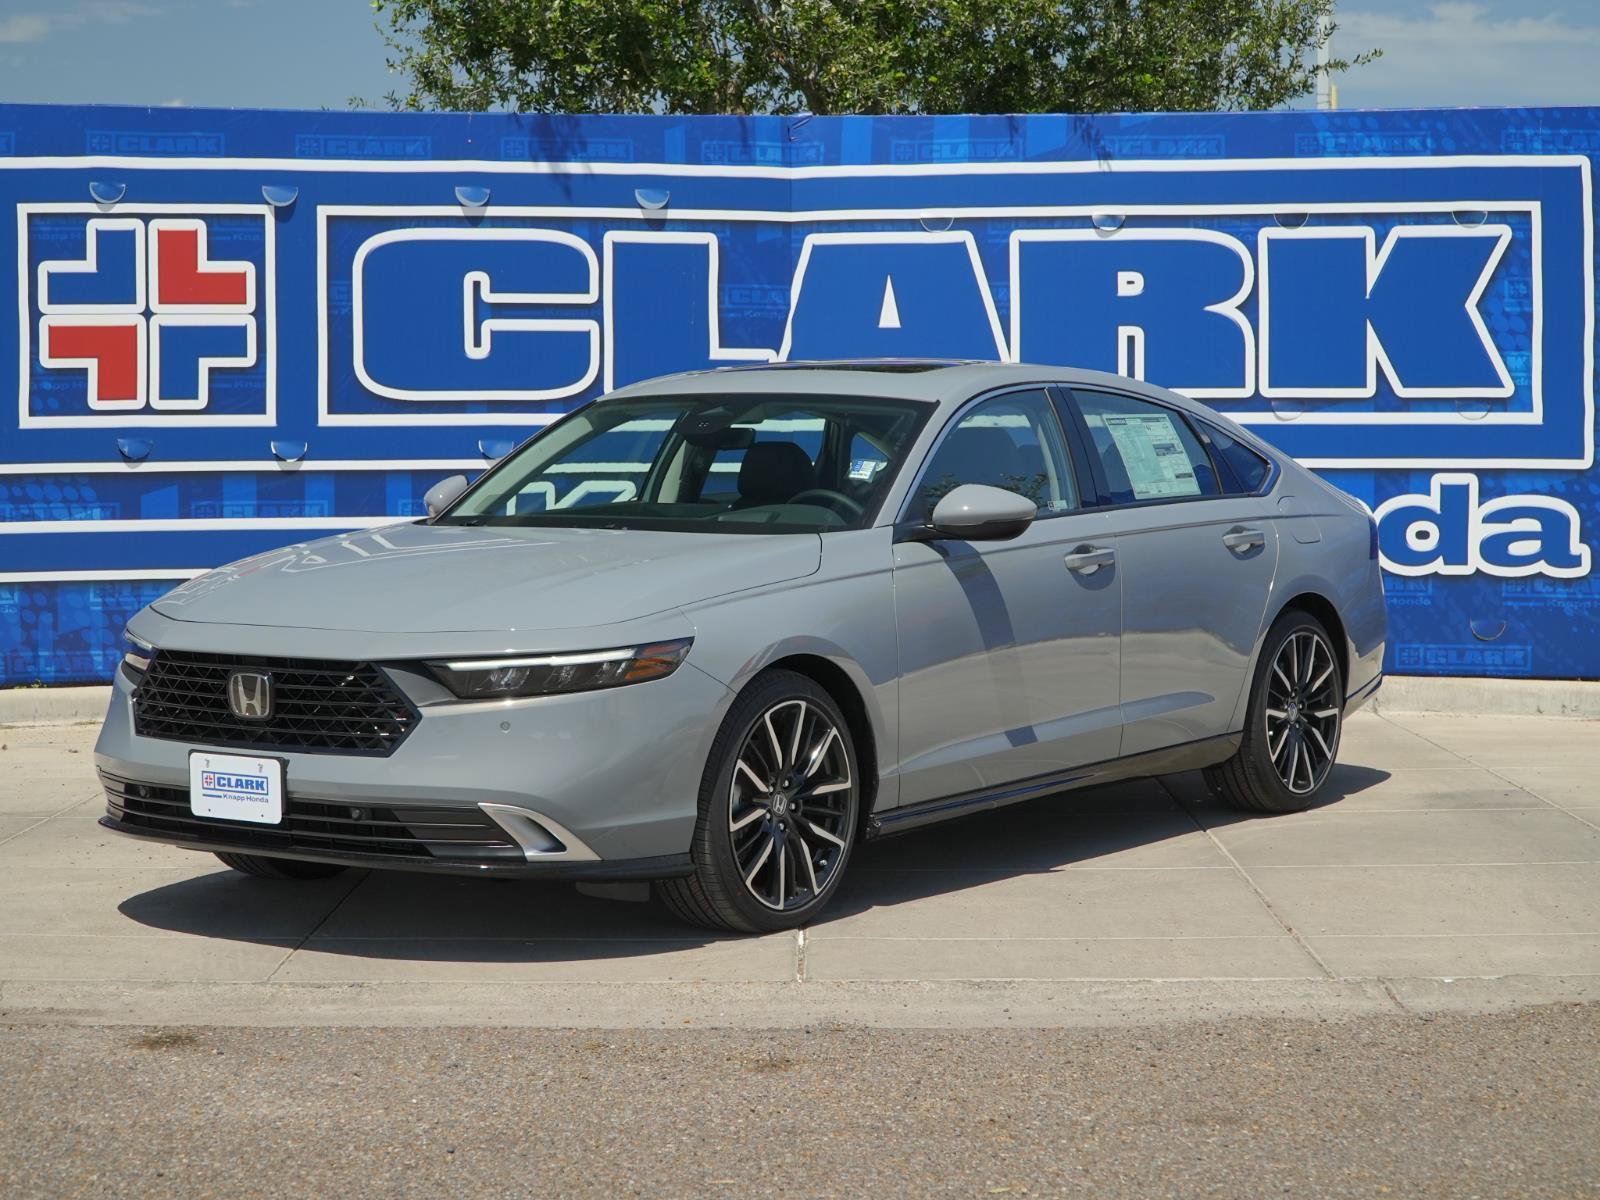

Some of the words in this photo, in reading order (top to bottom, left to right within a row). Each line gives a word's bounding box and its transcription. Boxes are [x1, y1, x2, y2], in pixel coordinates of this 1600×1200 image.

[118, 137, 218, 152] CLARK
[327, 140, 424, 155] CLARK
[920, 144, 1014, 158] CLARK
[352, 227, 1514, 403] CLARK
[1426, 650, 1525, 665] CLARK
[217, 776, 265, 791] CLARK
[223, 793, 245, 802] Knapp
[246, 795, 269, 803] Honda
